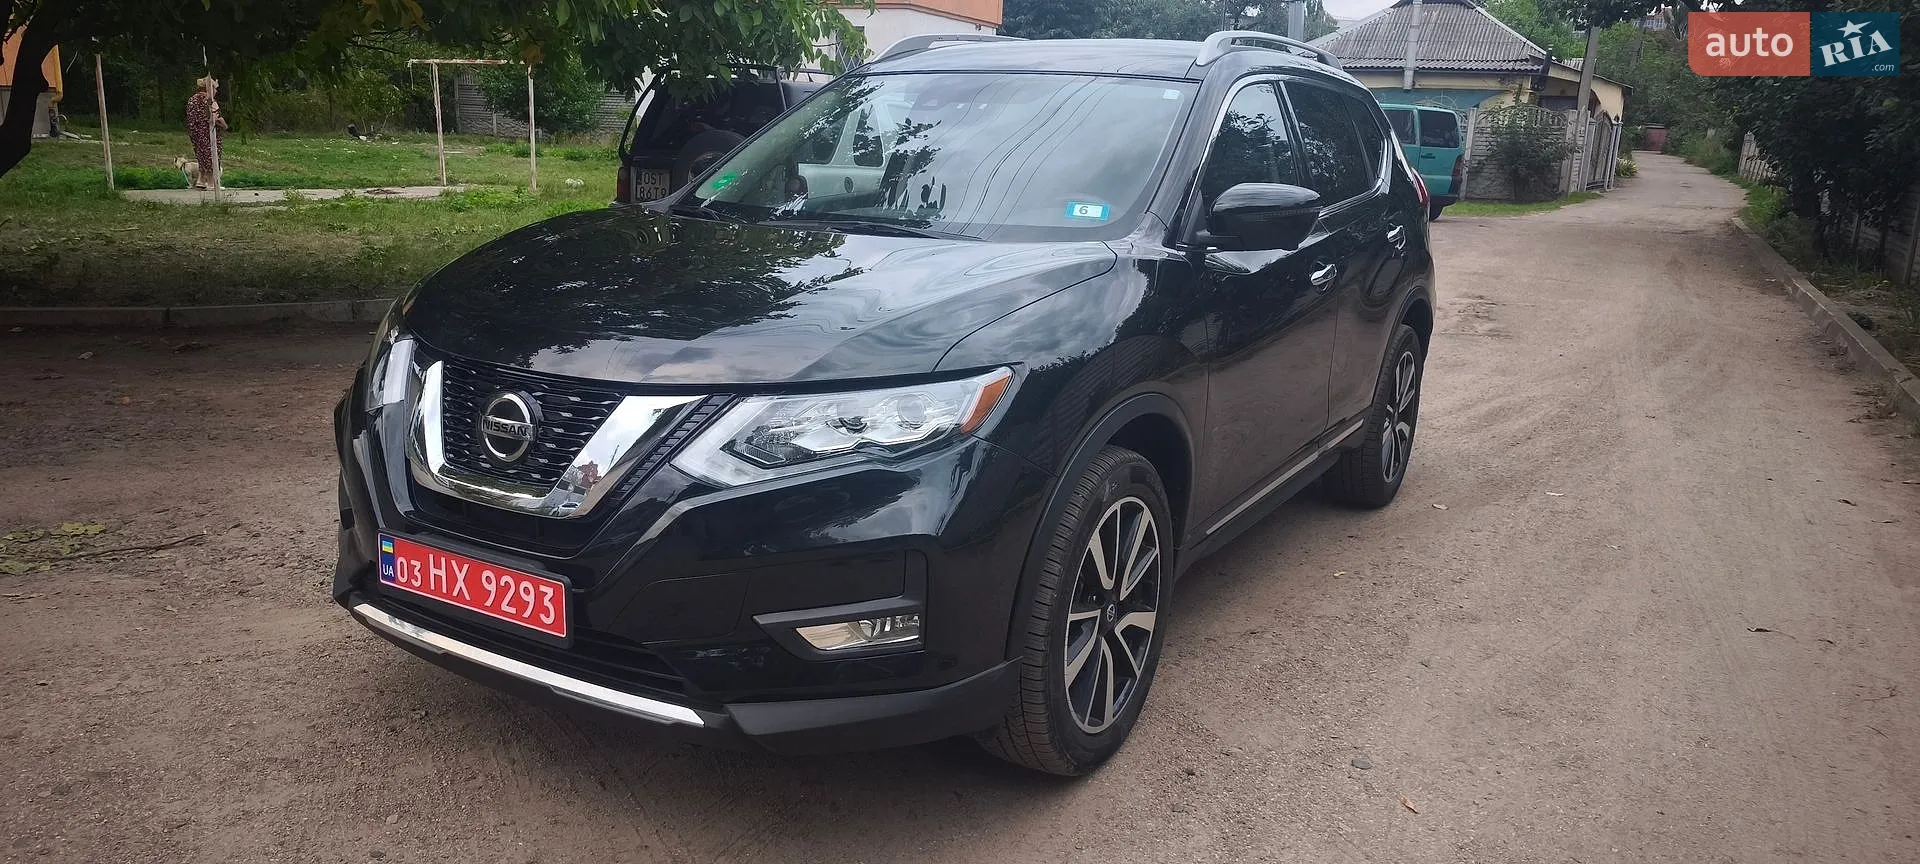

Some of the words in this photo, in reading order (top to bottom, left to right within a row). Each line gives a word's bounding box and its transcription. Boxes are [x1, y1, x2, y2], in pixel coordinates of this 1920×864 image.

[643, 172, 664, 186] OST
[1079, 206, 1089, 215] 6
[483, 420, 528, 437] NISSAN
[382, 563, 394, 577] UA
[396, 556, 422, 588] 03
[428, 553, 471, 601] HX
[481, 569, 556, 625] 9293
